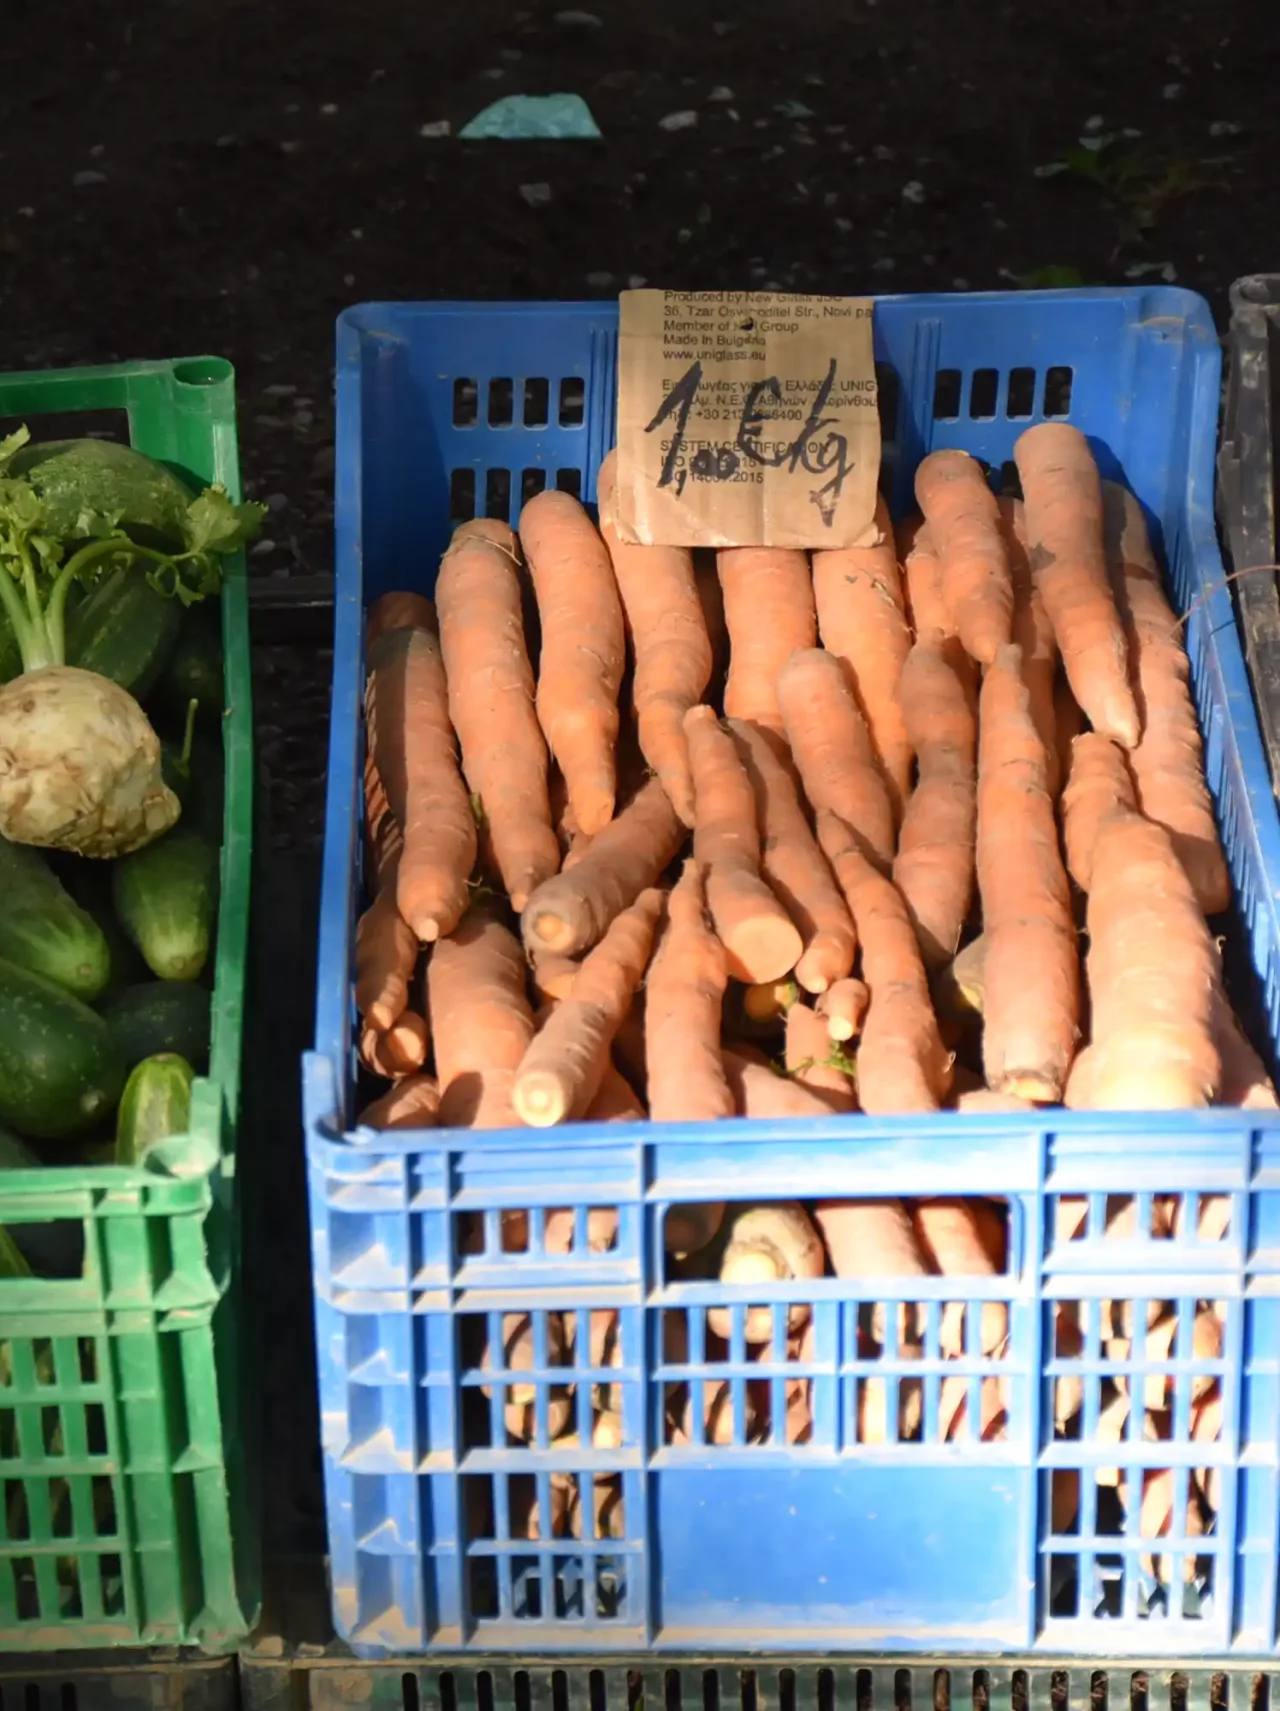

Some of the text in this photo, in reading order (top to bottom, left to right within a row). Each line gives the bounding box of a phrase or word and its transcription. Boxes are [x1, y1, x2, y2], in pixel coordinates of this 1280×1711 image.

[664, 290, 724, 302] Produced
[727, 291, 743, 304] by
[745, 291, 773, 303] New
[686, 304, 715, 317] Tzar
[823, 305, 852, 317] Novi
[663, 320, 714, 332] Member
[717, 319, 730, 332] of
[760, 321, 799, 334] Group
[663, 334, 699, 346] Made
[663, 349, 767, 363] www.uniglass.eu
[695, 409, 720, 421] +30
